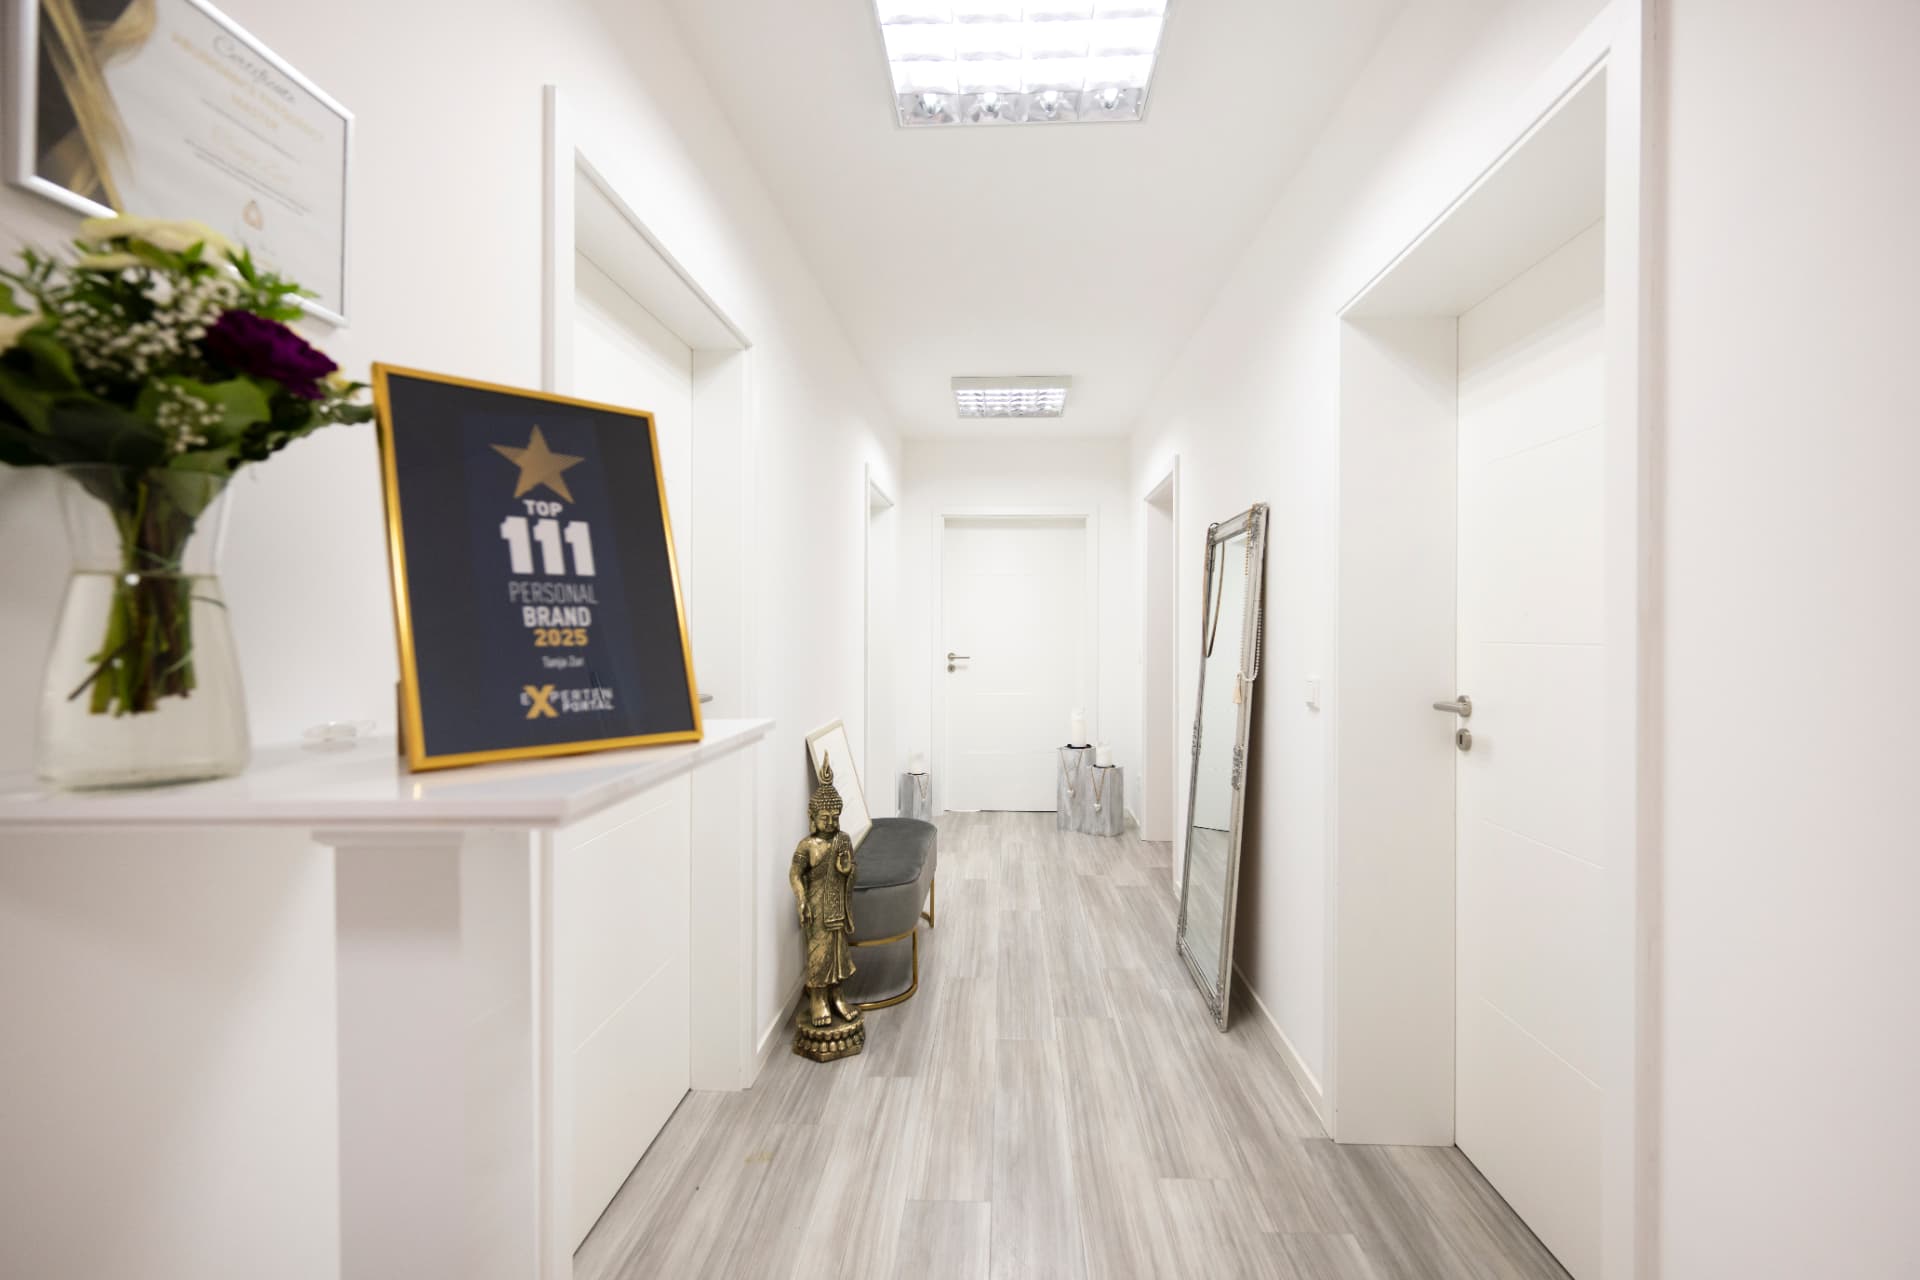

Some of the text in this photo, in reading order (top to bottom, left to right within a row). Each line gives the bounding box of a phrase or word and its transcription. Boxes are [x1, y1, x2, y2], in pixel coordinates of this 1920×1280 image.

[523, 500, 563, 517] TOP
[500, 516, 596, 576] 111
[508, 581, 598, 605] PERSONAL
[522, 605, 592, 628] BRAND
[533, 628, 589, 647] 2025
[561, 700, 615, 713] PORTAL
